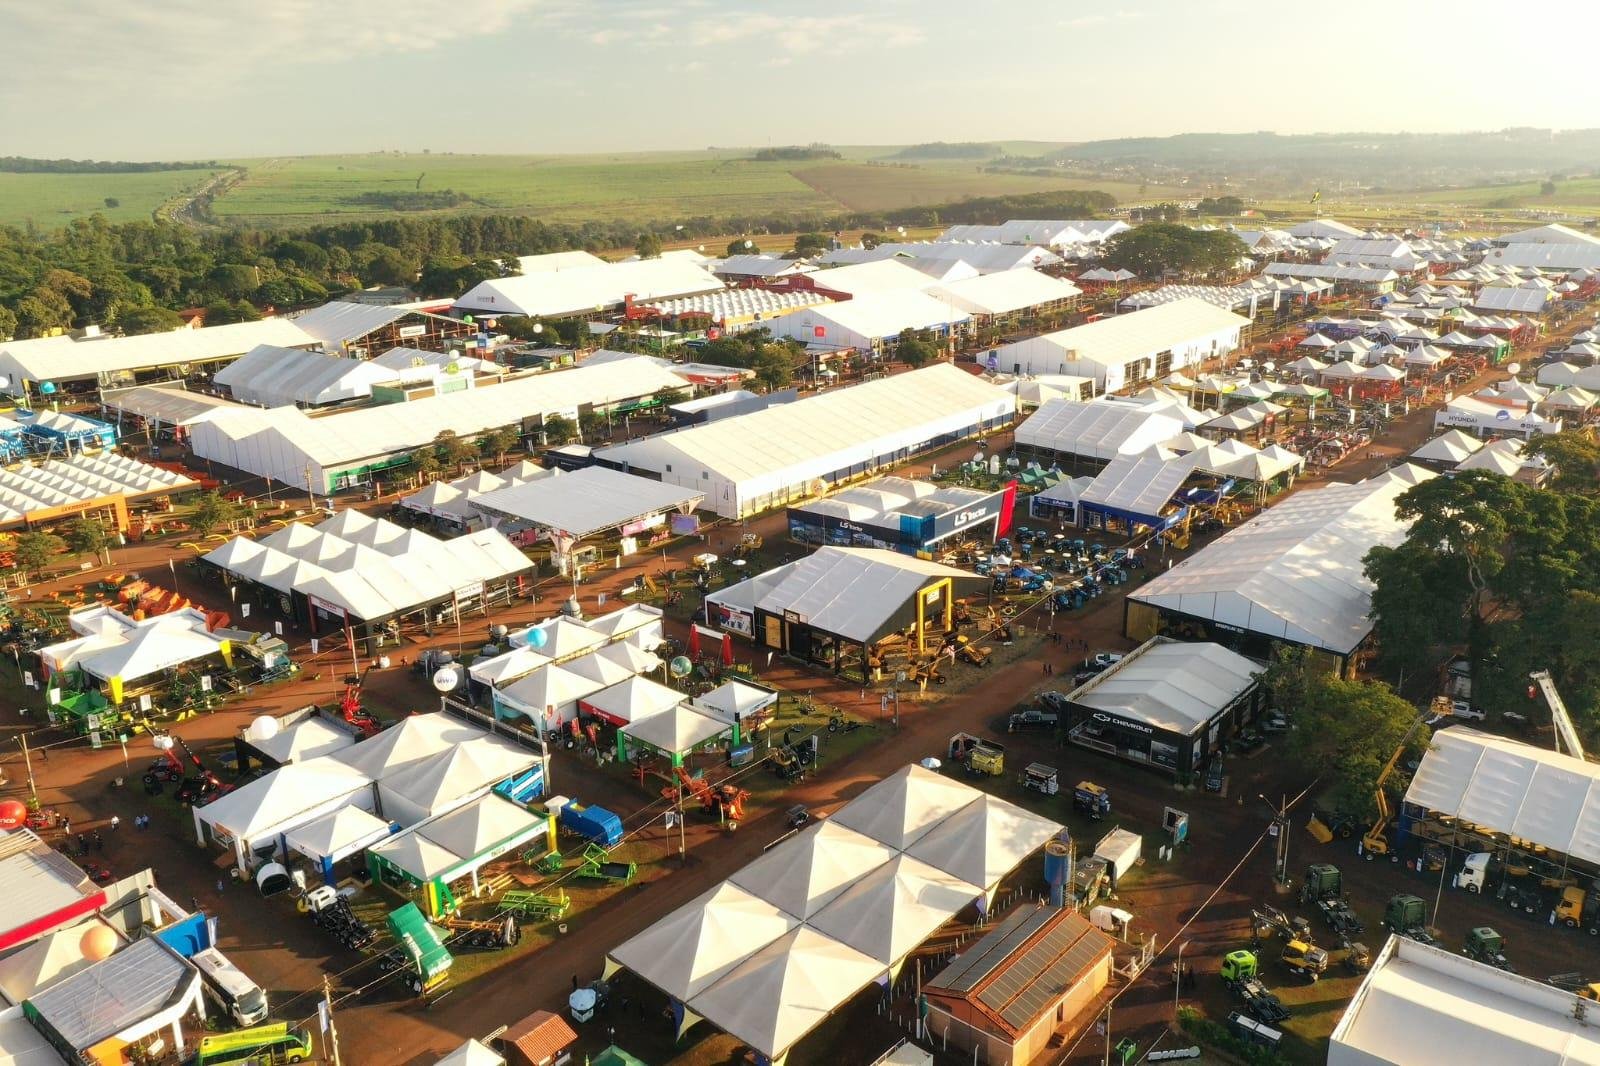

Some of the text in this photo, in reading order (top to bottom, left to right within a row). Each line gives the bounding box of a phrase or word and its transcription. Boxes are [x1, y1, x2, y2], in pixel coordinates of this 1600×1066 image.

[1448, 415, 1478, 424] HYUNDAI
[954, 511, 968, 527] LS
[1112, 718, 1153, 734] CHEVROLET
